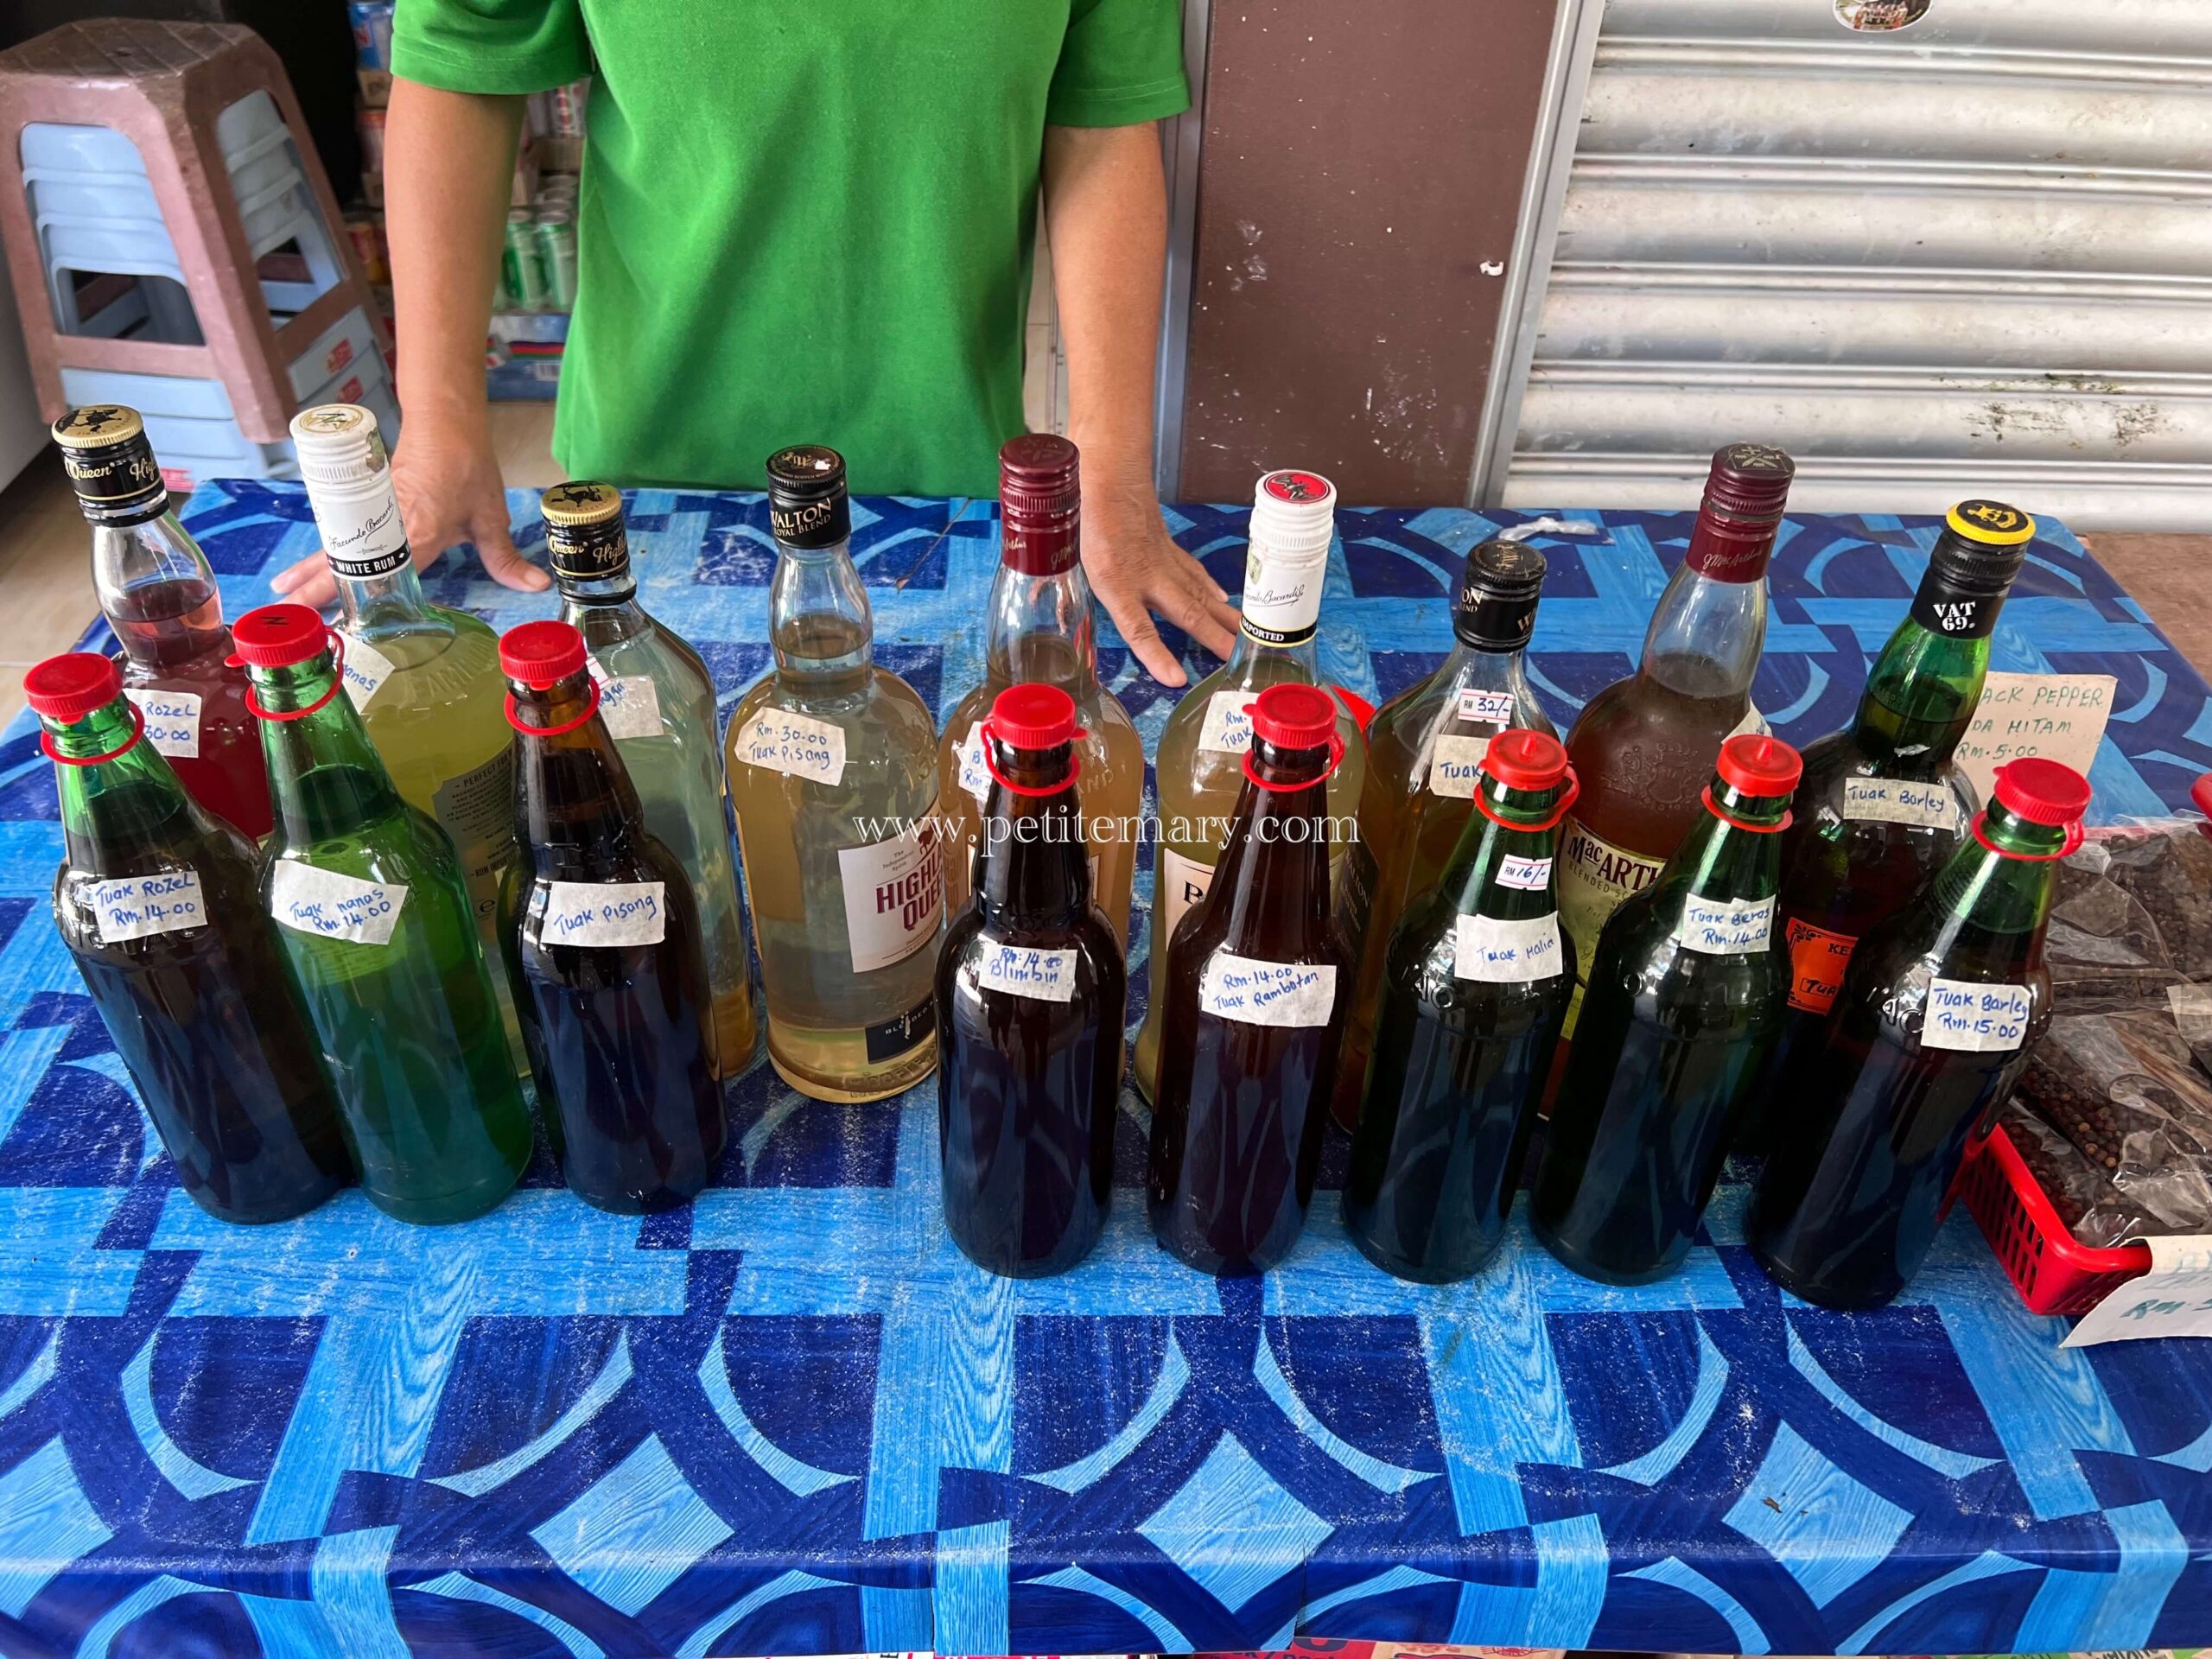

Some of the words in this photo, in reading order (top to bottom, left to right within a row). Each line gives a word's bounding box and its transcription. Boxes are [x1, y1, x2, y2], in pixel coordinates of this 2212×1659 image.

[798, 514, 830, 534] BLEND
[335, 557, 372, 575] WHITE
[374, 556, 397, 570] RUM
[1932, 601, 1977, 619] VAT
[1242, 615, 1285, 643] IMPORTED
[1464, 699, 1473, 709] RM
[2032, 685, 2103, 708] PEPPER
[2006, 717, 2072, 735] HITAM
[1504, 866, 1516, 876] RM
[553, 909, 594, 935] Tuak
[1933, 988, 1974, 1007] Tuak
